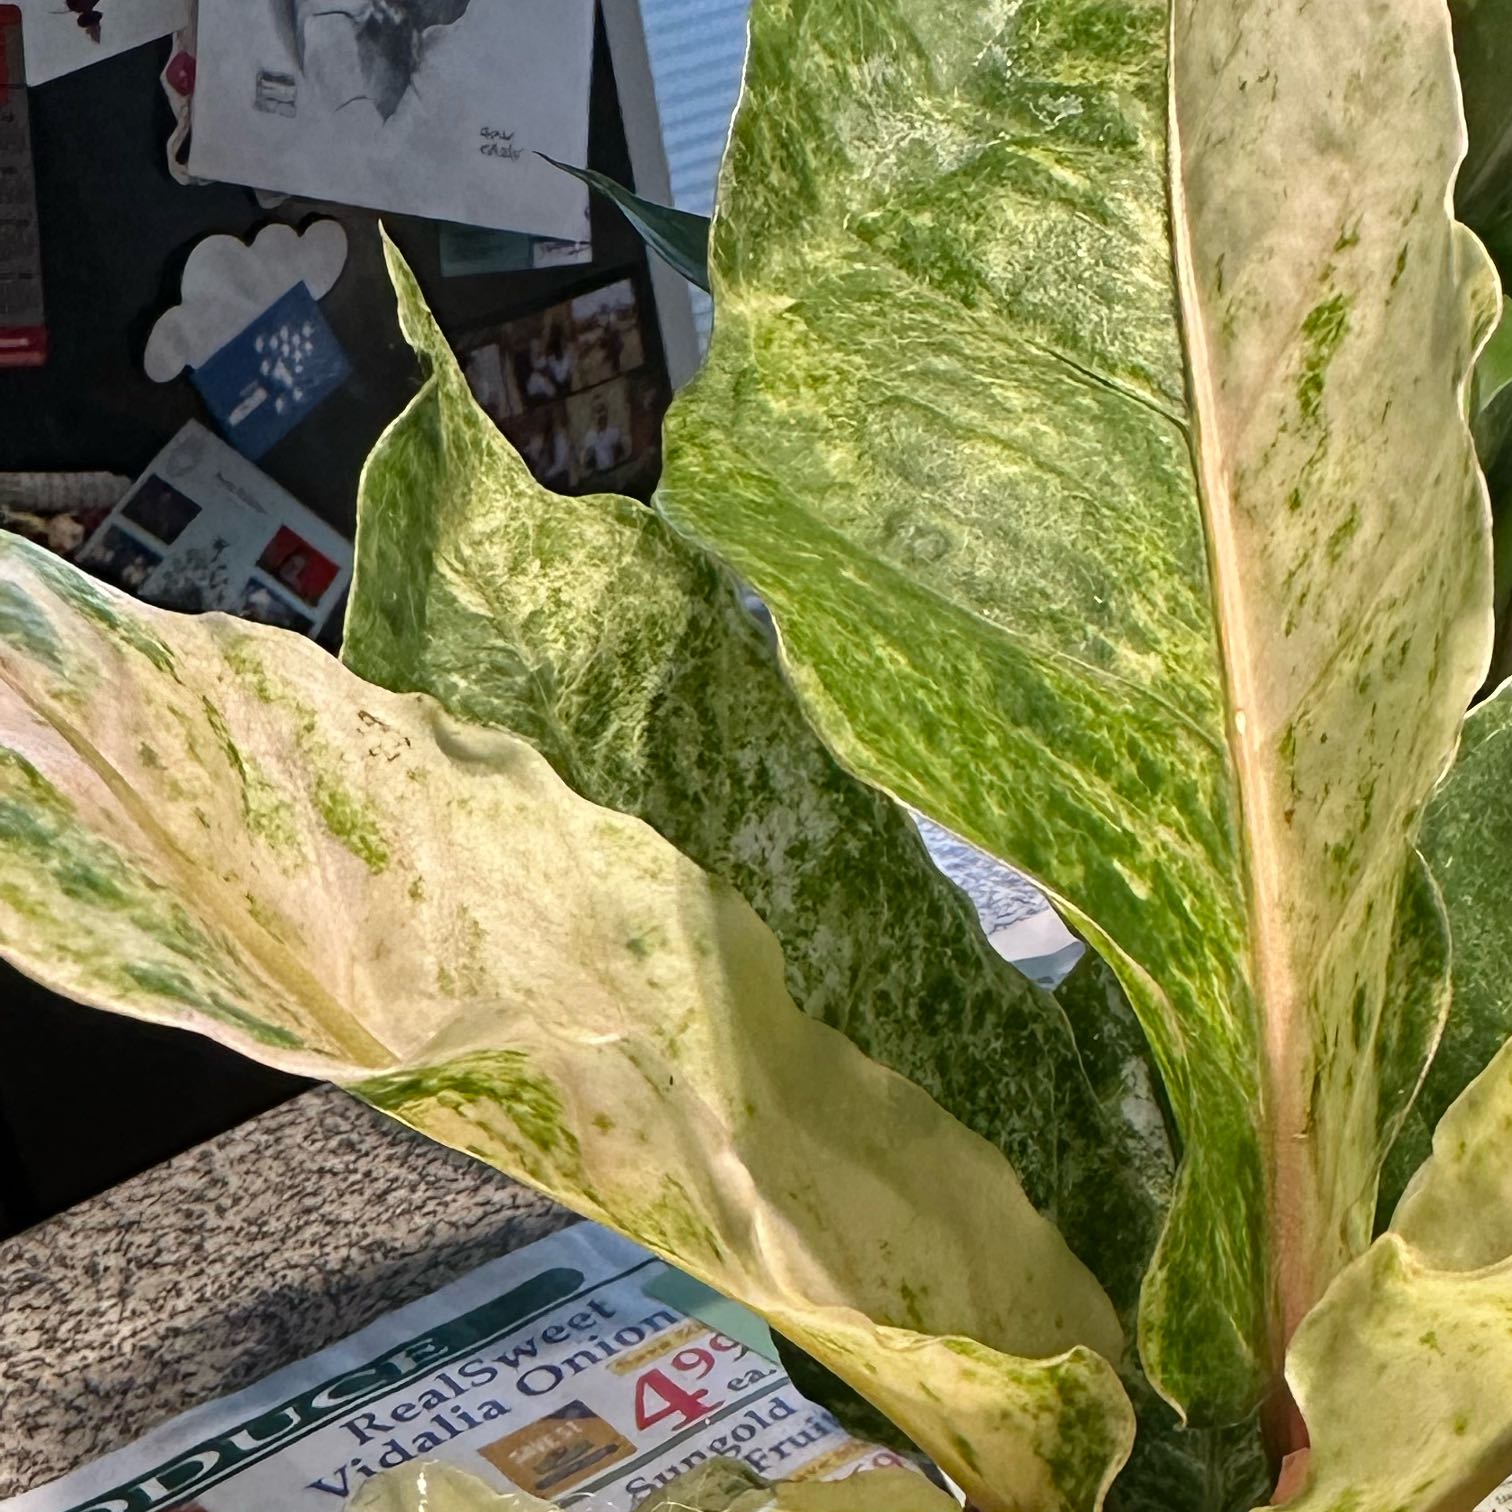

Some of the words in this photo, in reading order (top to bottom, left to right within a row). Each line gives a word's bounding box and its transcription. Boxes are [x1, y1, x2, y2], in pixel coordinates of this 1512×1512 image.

[305, 1395, 512, 1499] Vidalia
[515, 1309, 681, 1396] Onion
[339, 1299, 617, 1447] RealSweet
[624, 1396, 799, 1499] Sungold
